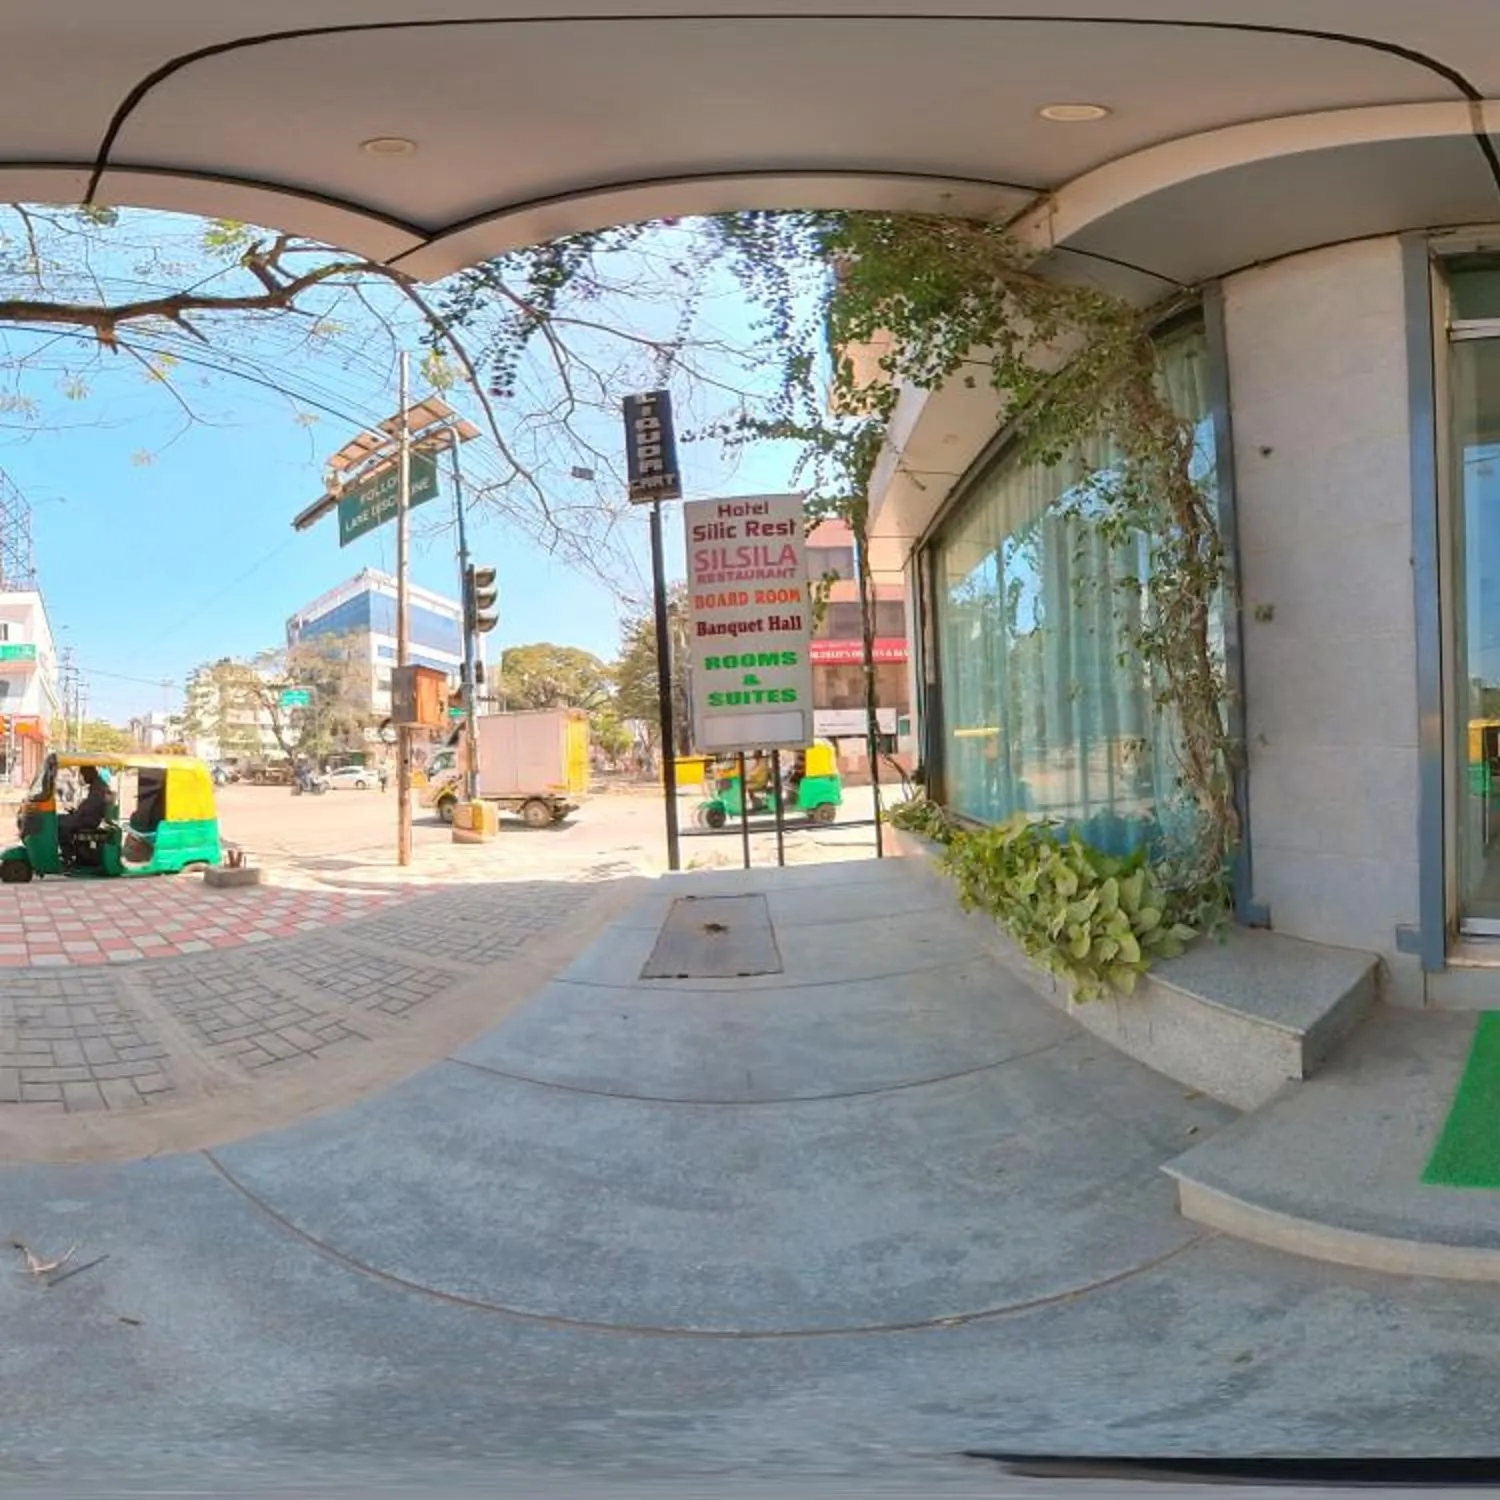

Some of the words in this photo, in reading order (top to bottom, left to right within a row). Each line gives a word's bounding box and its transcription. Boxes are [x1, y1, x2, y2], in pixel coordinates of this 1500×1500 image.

[361, 476, 400, 504] FOLLO
[717, 501, 769, 518] Hotel
[693, 521, 737, 543] Silic
[745, 518, 796, 537] Rest
[694, 543, 798, 573] SILSILA
[696, 567, 796, 584] RESTAURANT
[695, 591, 749, 610] BOARD
[754, 589, 801, 605] ROOM
[696, 619, 763, 637] Banquet
[768, 615, 802, 631] Hall
[705, 651, 797, 671] ROOMS
[707, 688, 797, 707] SUITES
